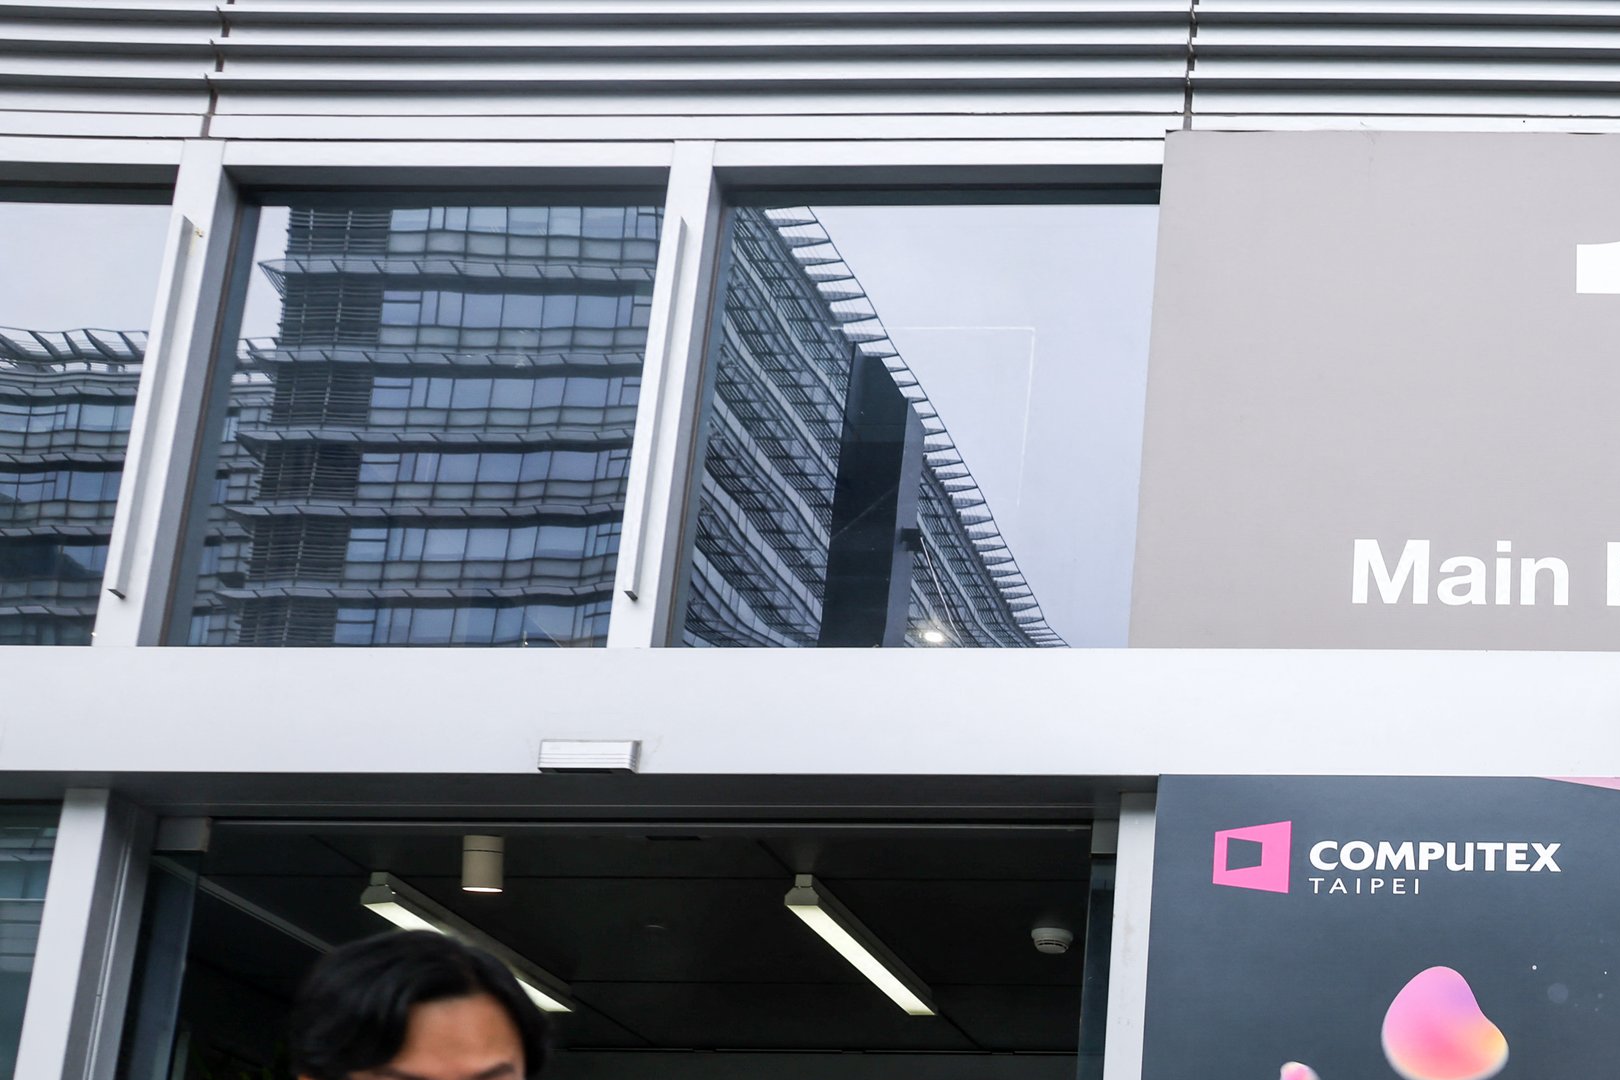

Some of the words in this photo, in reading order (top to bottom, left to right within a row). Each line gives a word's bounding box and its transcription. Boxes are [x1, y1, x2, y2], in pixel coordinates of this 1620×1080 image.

[1351, 538, 1570, 606] Main
[1309, 840, 1562, 873] COMPUTEX
[1308, 877, 1419, 895] TAIPEI
